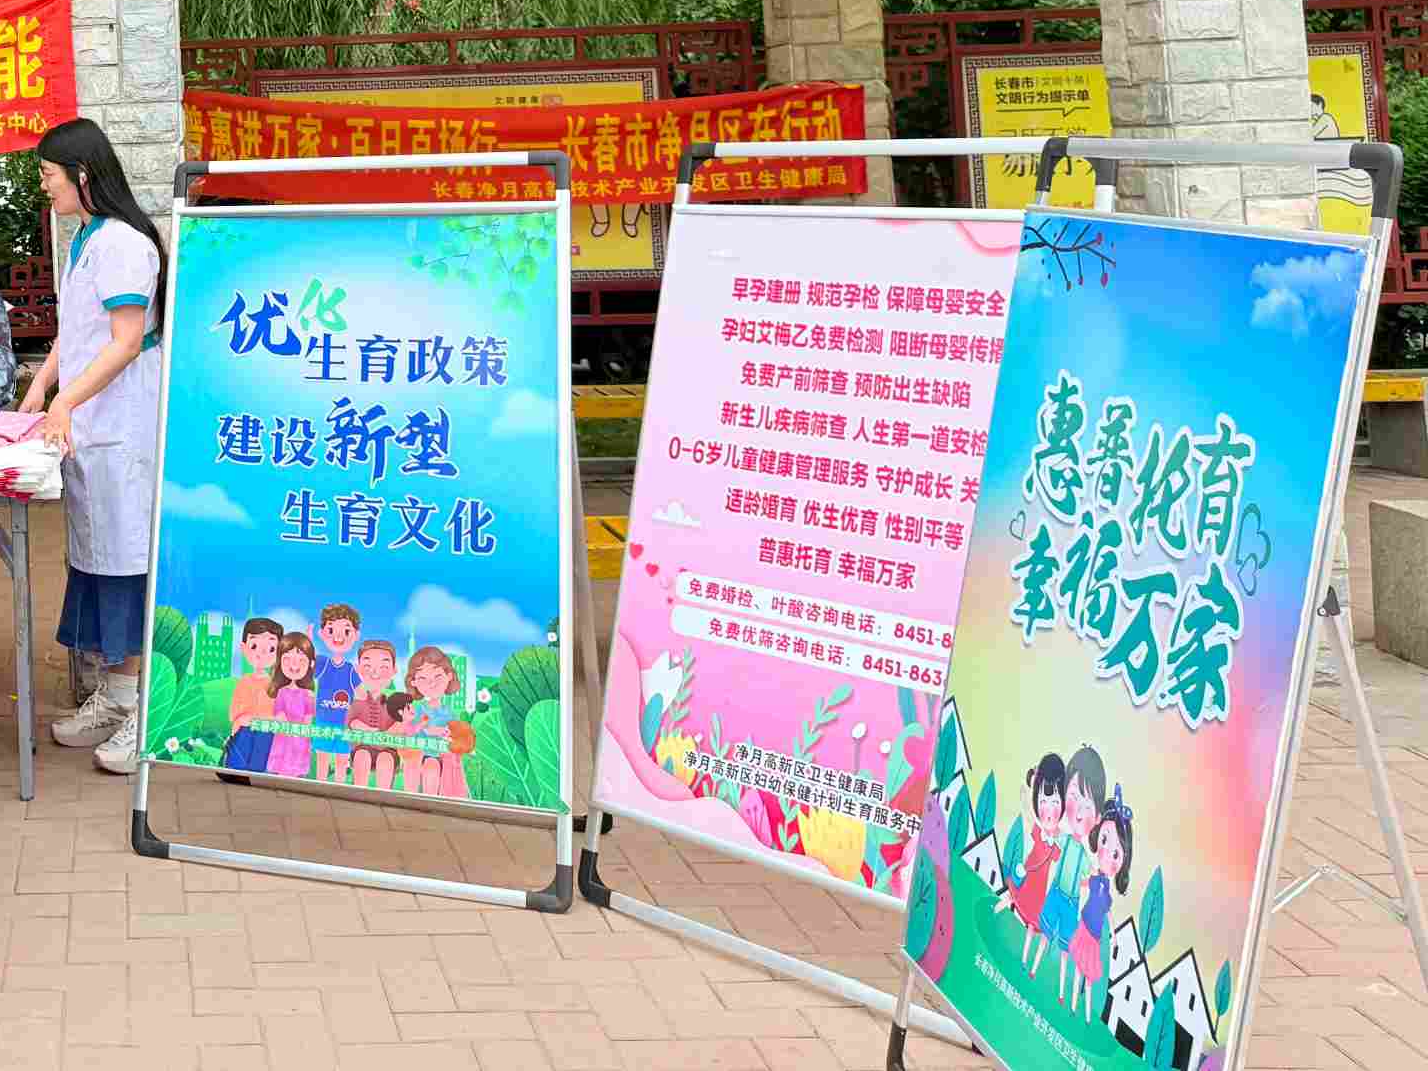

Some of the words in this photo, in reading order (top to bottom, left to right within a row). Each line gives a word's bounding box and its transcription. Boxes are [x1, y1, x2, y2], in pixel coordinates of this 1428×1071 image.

[217, 277, 349, 356] 优化
[732, 277, 801, 305] 早孕建册
[807, 281, 880, 310] 规范孕检
[887, 285, 1005, 317] 保障母婴安全
[304, 333, 509, 387] 生育政策
[721, 317, 884, 355] 孕妇艾梅乙免费检测
[890, 330, 1004, 363] 阻断母婴传播
[740, 361, 849, 396] 免费产前筛查
[854, 372, 971, 409] 预防出生缺陷
[216, 398, 458, 487] 建设新型
[720, 401, 848, 441] 新生儿疾病筛查
[852, 417, 988, 457] 人生第一道安检
[669, 436, 869, 489] 0-6岁儿童健康管理服务
[875, 464, 953, 501] 守护成长
[280, 489, 496, 554] 生育文化
[724, 488, 798, 523] 适龄婚育
[803, 500, 879, 537] 优生优育
[884, 512, 965, 551] 性别平等
[758, 537, 833, 576] 普惠托育
[838, 555, 917, 591] 幸福万家
[1013, 511, 1241, 722] 幸福万家
[862, 654, 947, 686] 8451-863
[734, 743, 885, 802] 净月高新区卫生健康局
